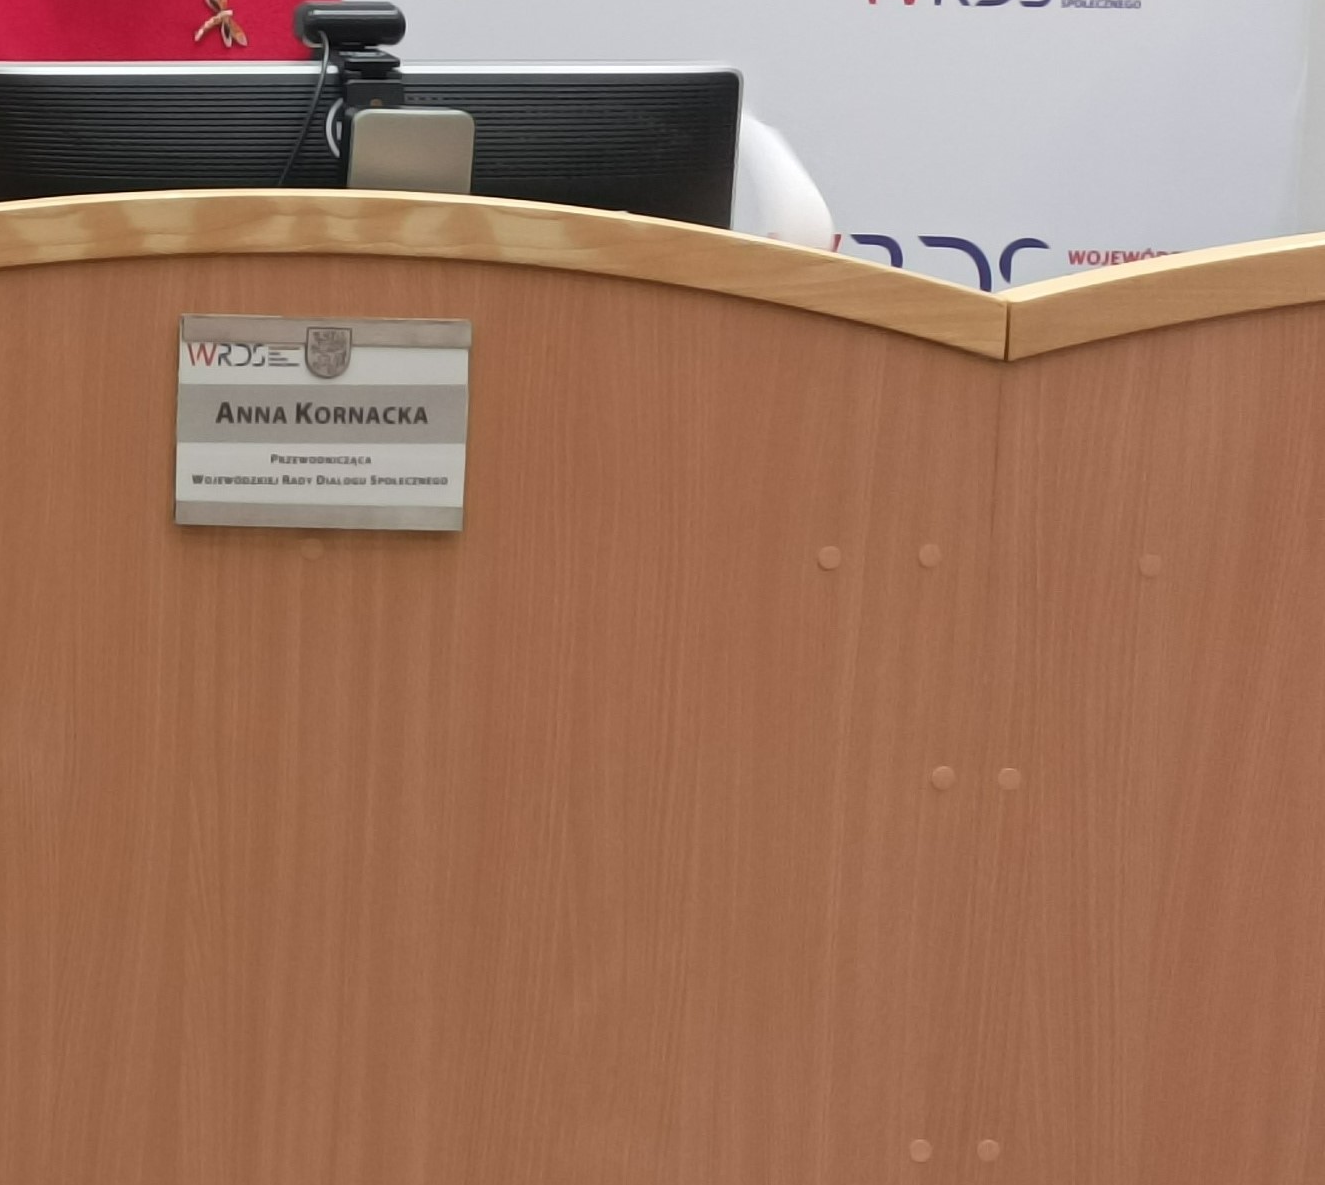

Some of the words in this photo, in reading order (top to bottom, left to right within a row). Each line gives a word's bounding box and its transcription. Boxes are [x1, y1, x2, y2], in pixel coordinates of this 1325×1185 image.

[187, 343, 265, 366] WRDS
[215, 402, 287, 424] ANNA
[295, 402, 429, 425] KORNACKA
